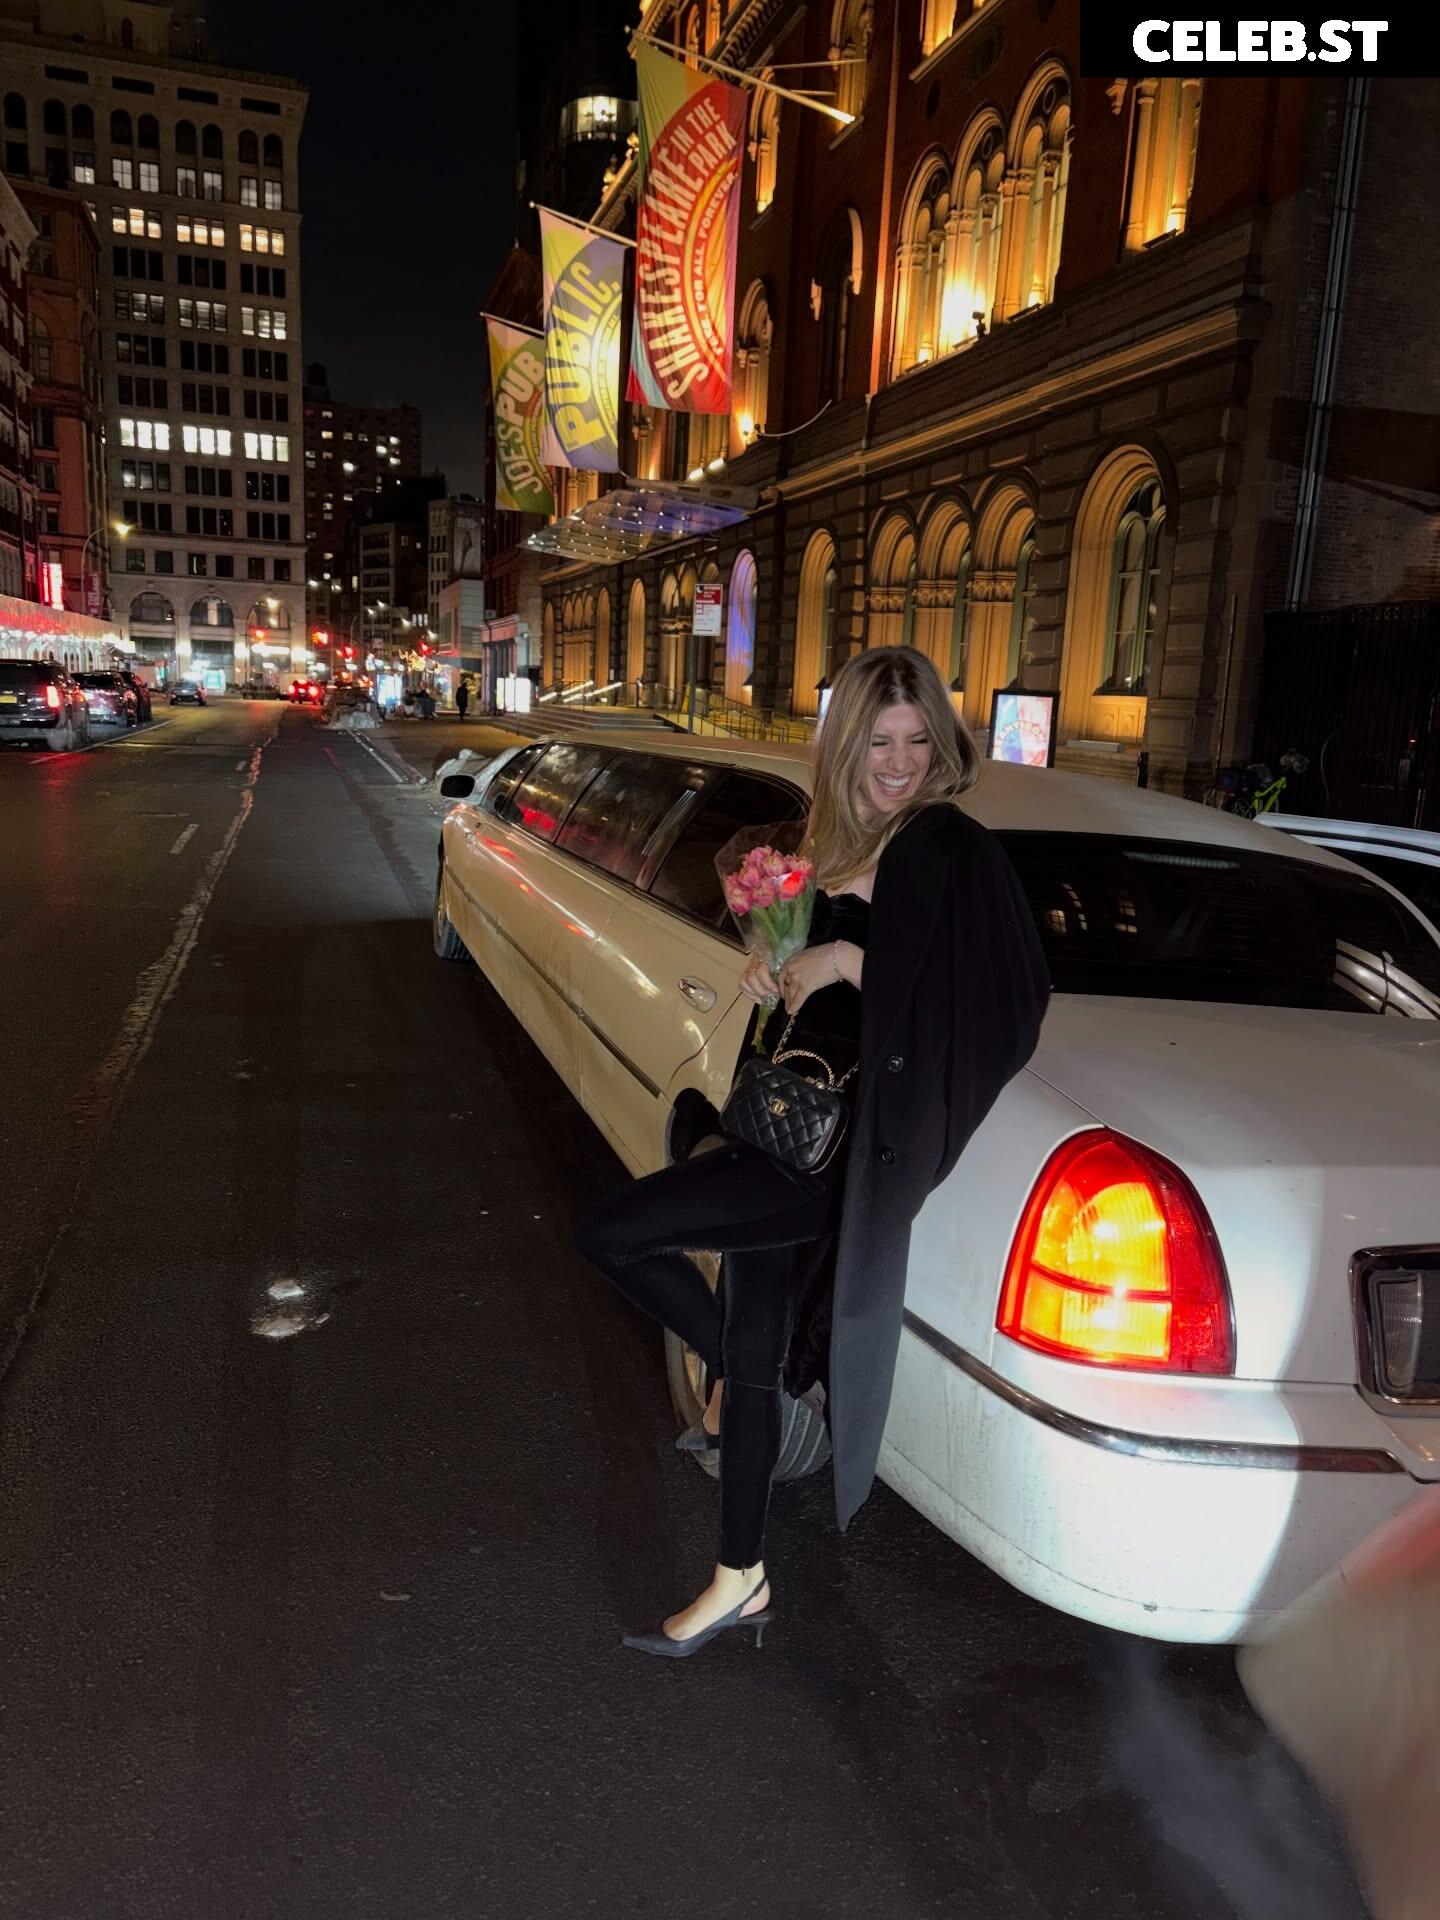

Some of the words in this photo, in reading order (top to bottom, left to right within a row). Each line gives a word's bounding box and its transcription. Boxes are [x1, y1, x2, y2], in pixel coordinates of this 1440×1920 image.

[670, 125, 695, 155] IN
[686, 97, 720, 135] THE
[687, 121, 737, 177] PARK
[639, 146, 709, 399] SHAKESPEARE
[497, 351, 546, 427] PUB
[497, 424, 543, 494] JOE'S
